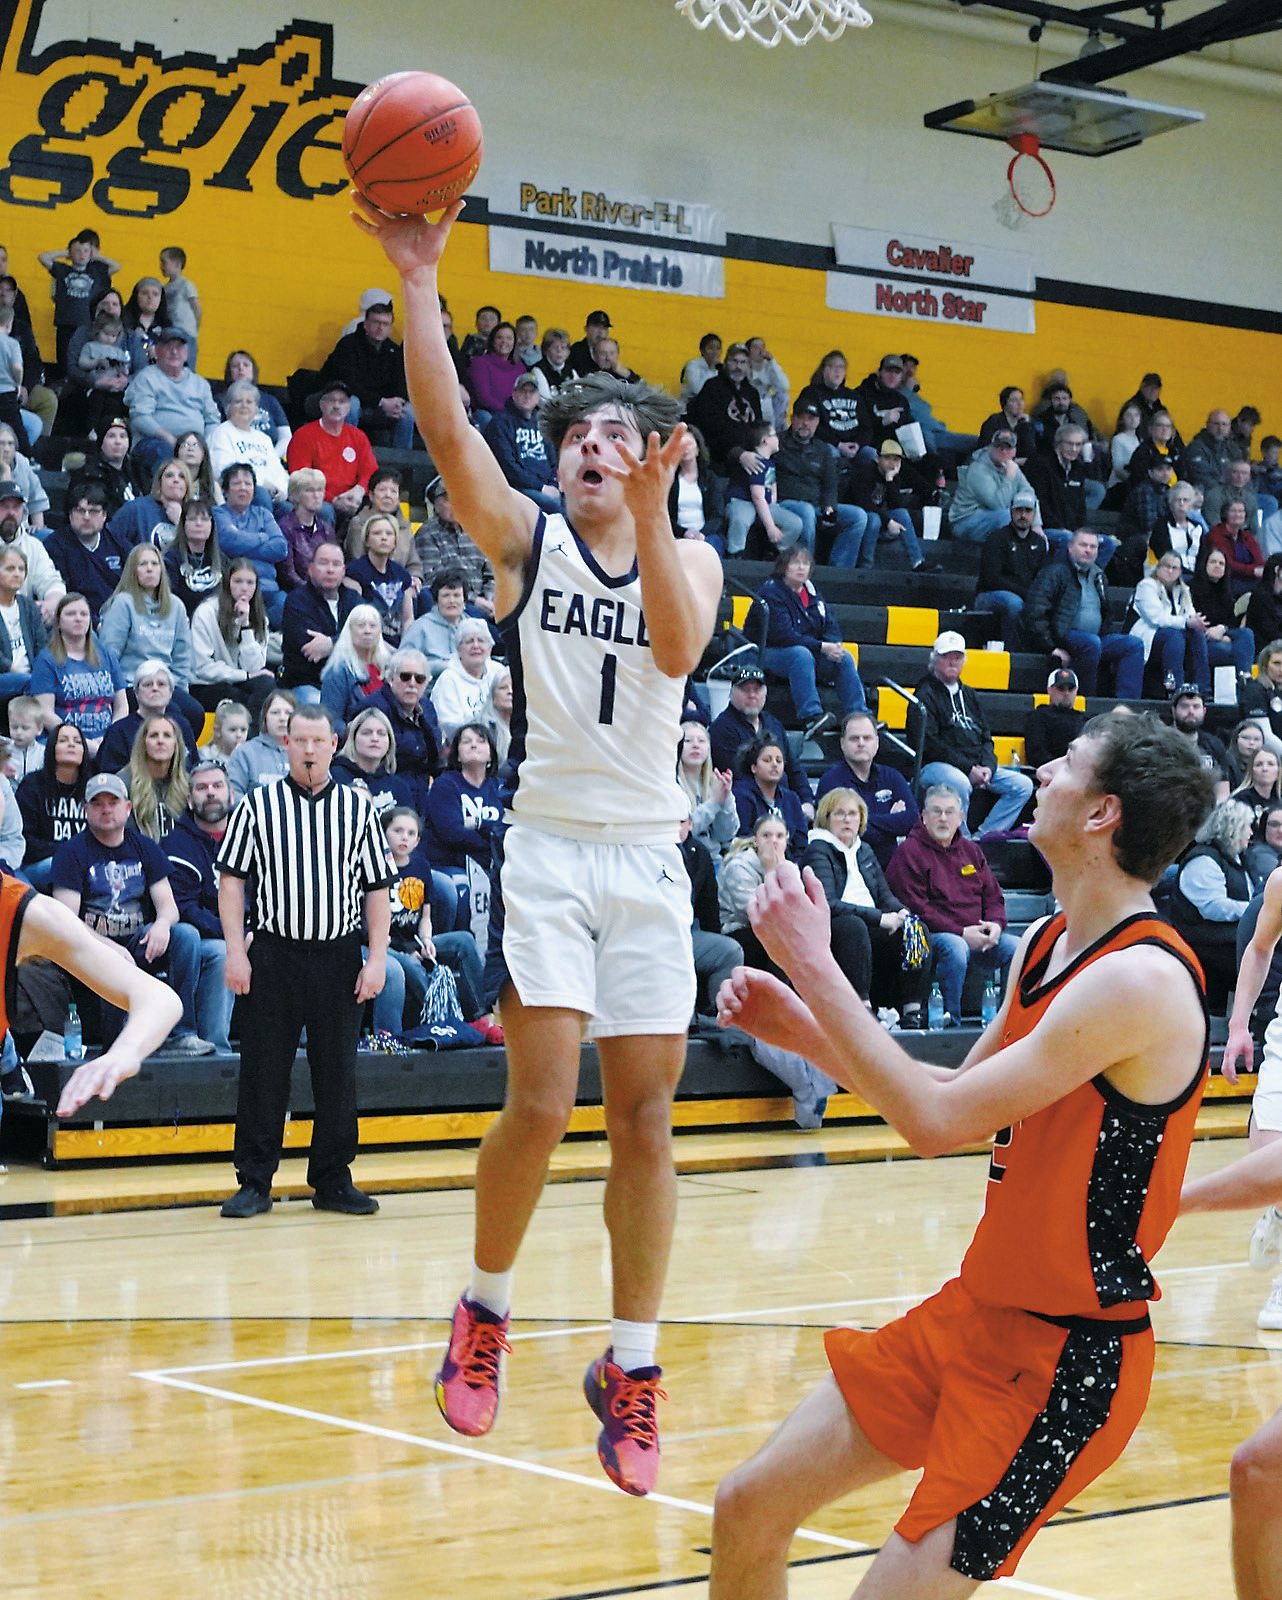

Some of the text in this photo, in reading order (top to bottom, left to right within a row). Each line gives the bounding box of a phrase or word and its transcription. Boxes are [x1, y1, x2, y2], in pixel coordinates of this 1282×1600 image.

[520, 182, 577, 219] Park
[524, 239, 684, 289] North Prairie
[886, 239, 974, 277] Cavalier
[876, 283, 987, 323] North Star
[598, 653, 617, 725] 1
